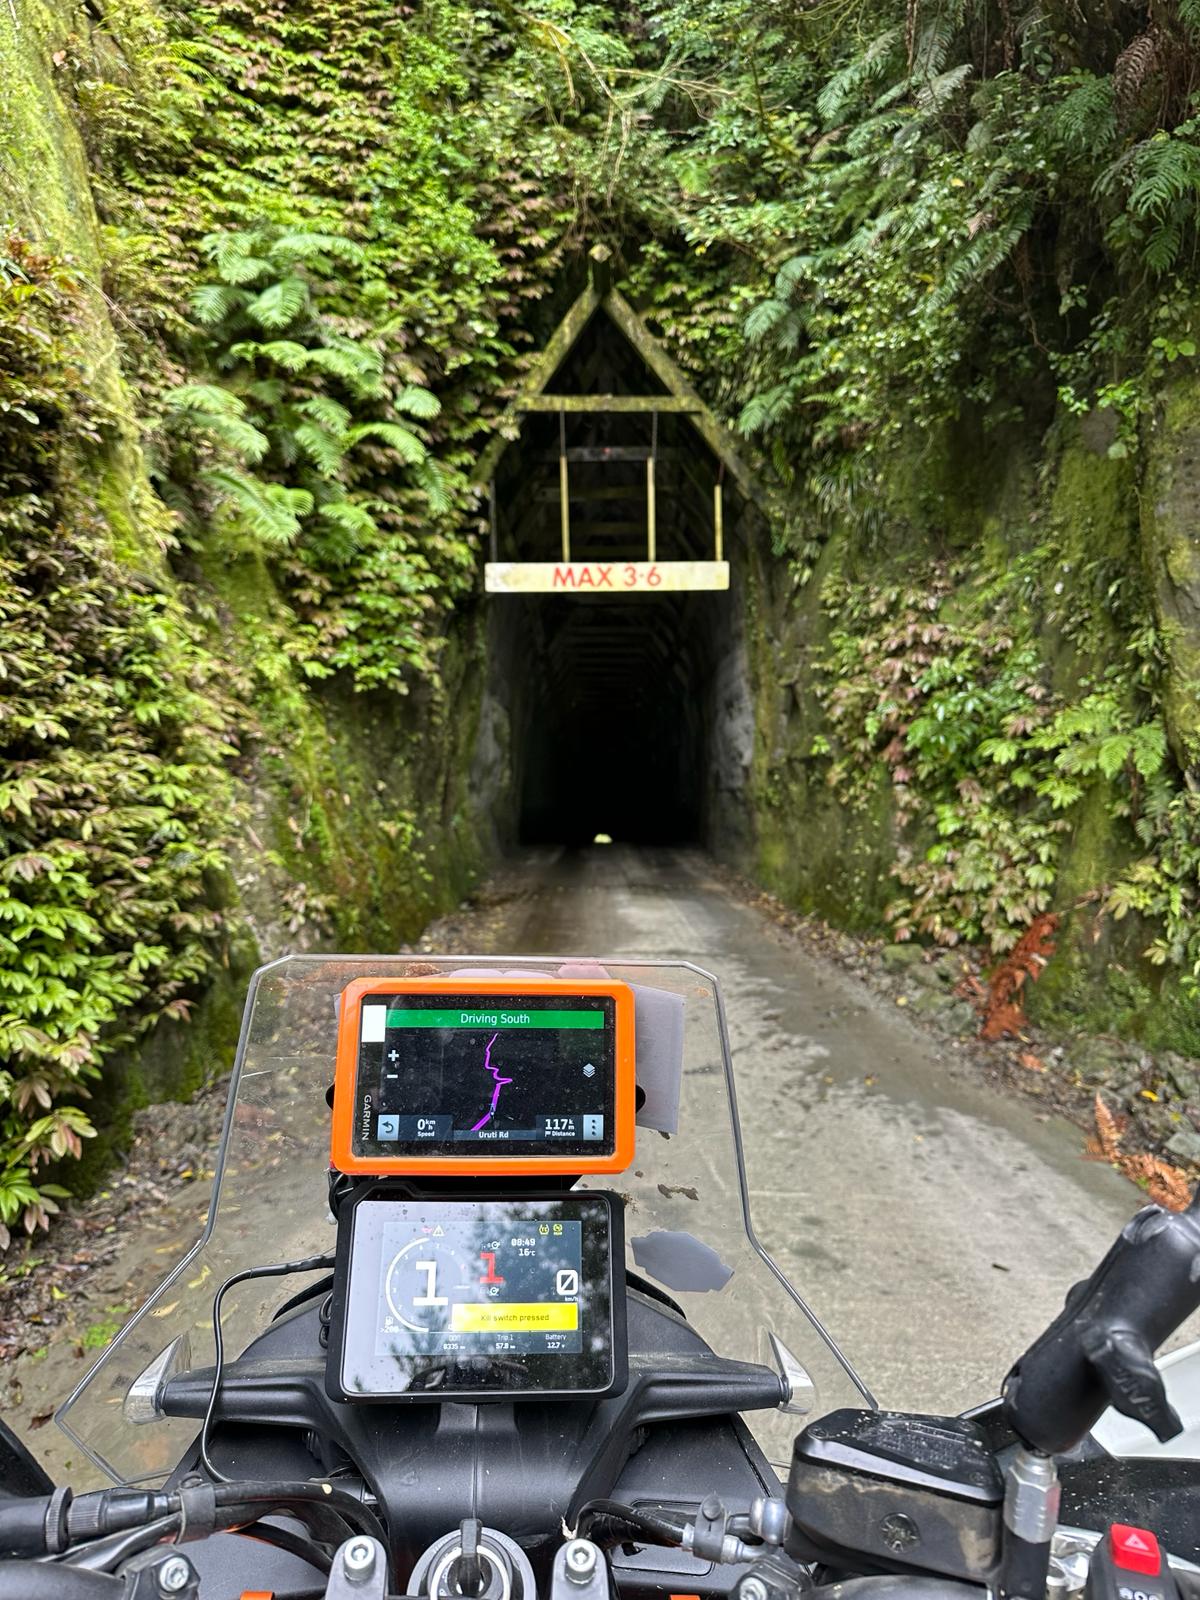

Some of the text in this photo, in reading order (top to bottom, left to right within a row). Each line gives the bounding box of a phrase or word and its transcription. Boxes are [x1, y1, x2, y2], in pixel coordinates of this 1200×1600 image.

[552, 566, 613, 588] MAX
[460, 1013, 531, 1026] Driving South
[362, 1094, 372, 1141] GARMIN
[417, 1118, 425, 1130] 0
[545, 1118, 568, 1130] 117
[478, 1131, 509, 1139] Uruti Rd
[511, 1238, 536, 1247] 08:49
[479, 1251, 504, 1284] 1
[413, 1261, 449, 1306] 1
[556, 1269, 579, 1296] 0
[519, 1314, 550, 1322] pressed
[545, 1333, 567, 1341] Battery
